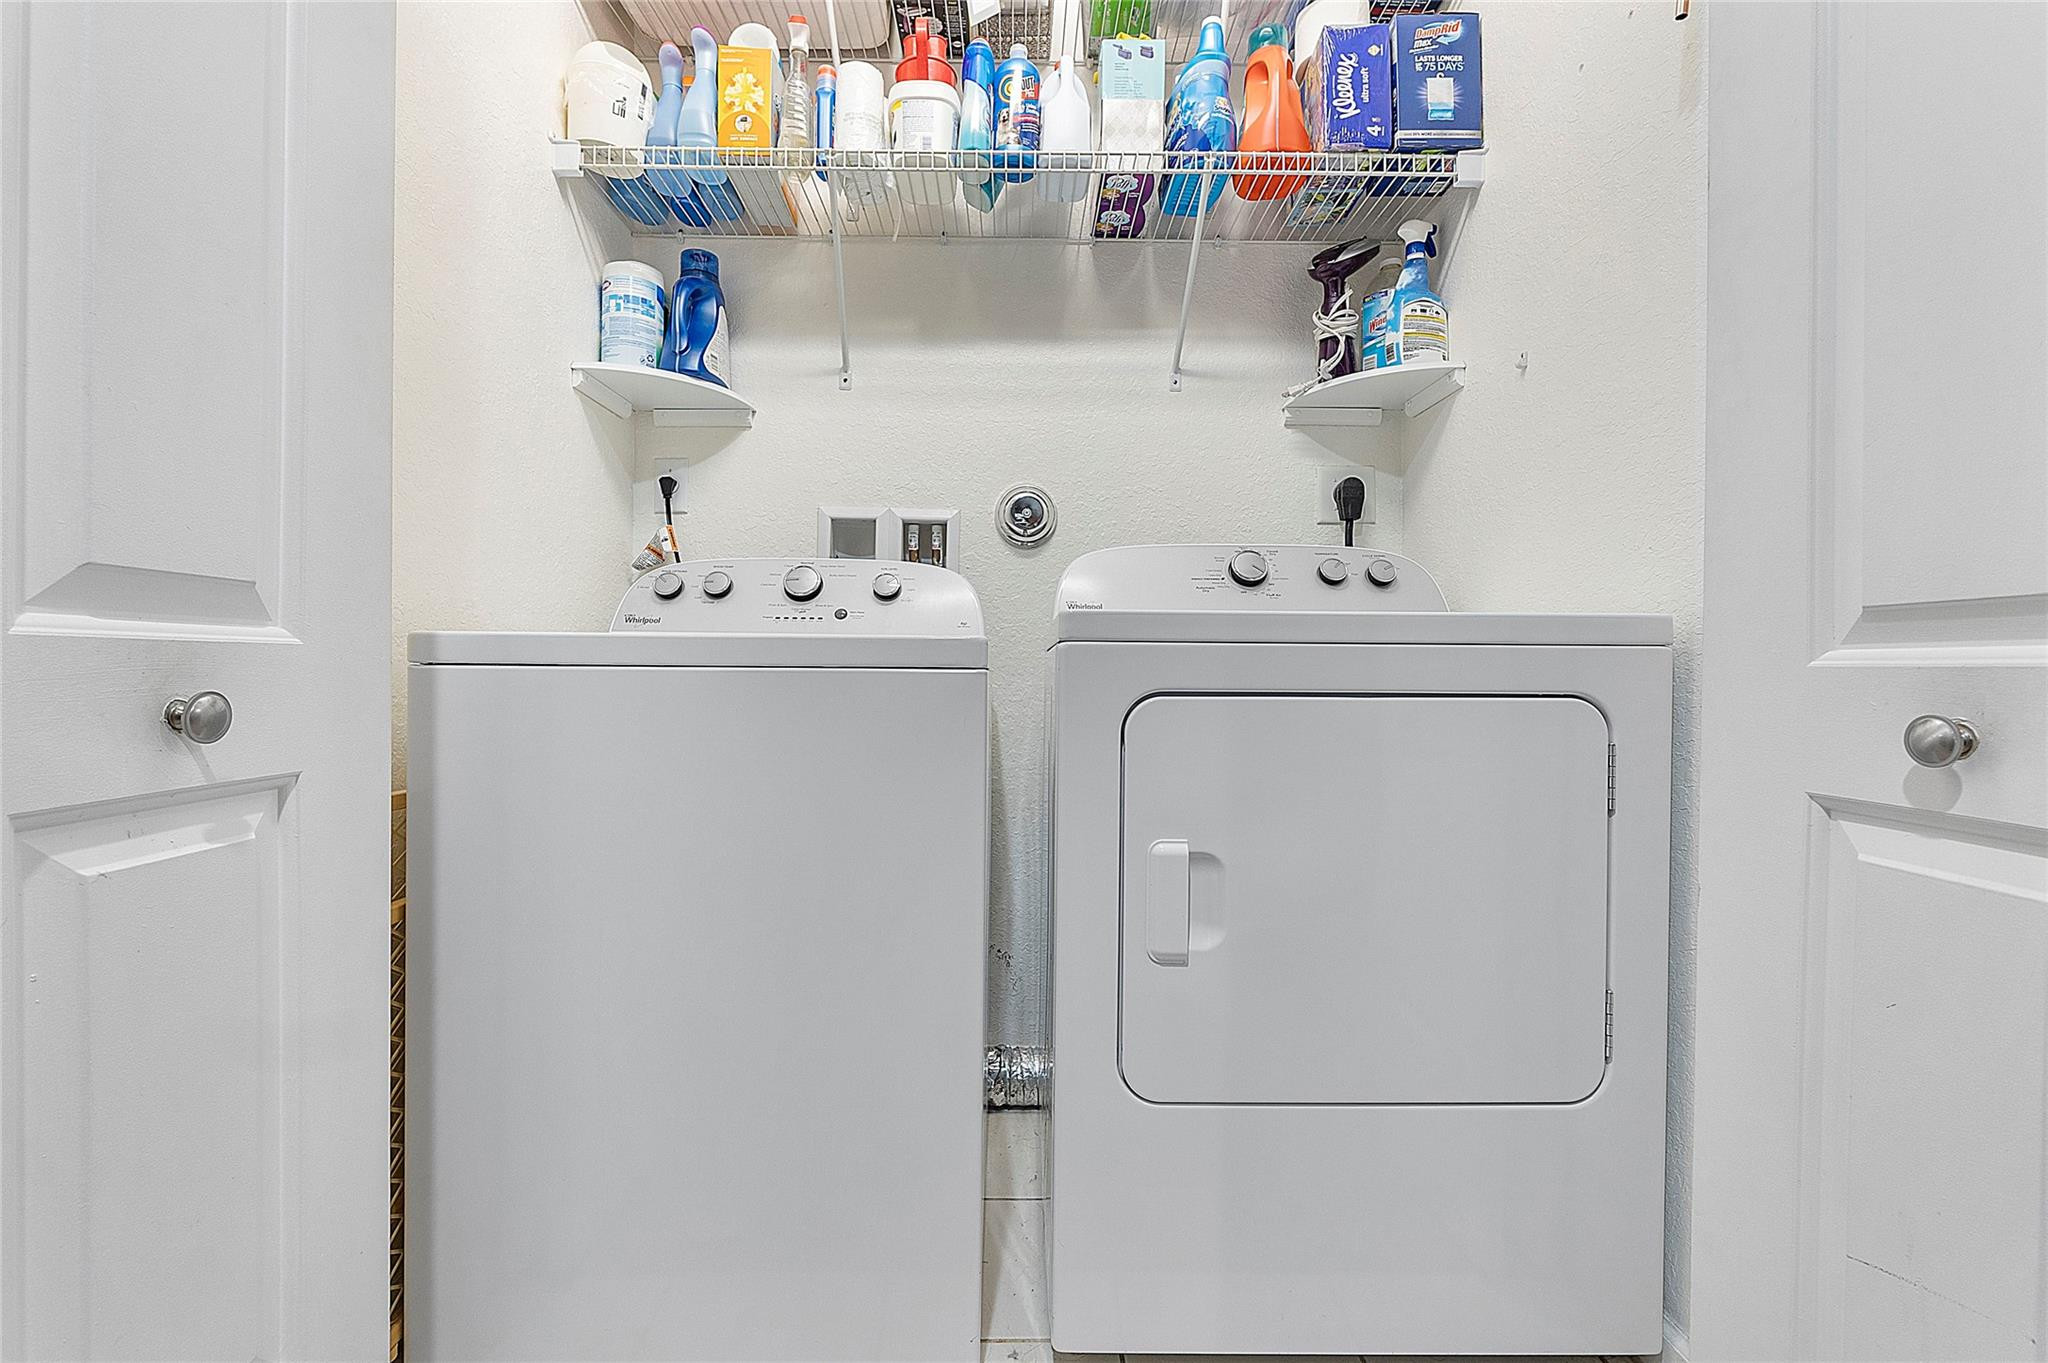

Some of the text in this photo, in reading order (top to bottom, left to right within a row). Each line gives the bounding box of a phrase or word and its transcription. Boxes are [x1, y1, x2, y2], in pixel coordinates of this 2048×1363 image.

[1416, 20, 1460, 39] DampRid
[1424, 62, 1436, 71] 75
[1438, 62, 1464, 71] DAYS
[1360, 66, 1369, 81] soft
[1332, 52, 1360, 119] Kleenex
[1367, 125, 1381, 137] 4
[624, 616, 662, 625] Whirlpool
